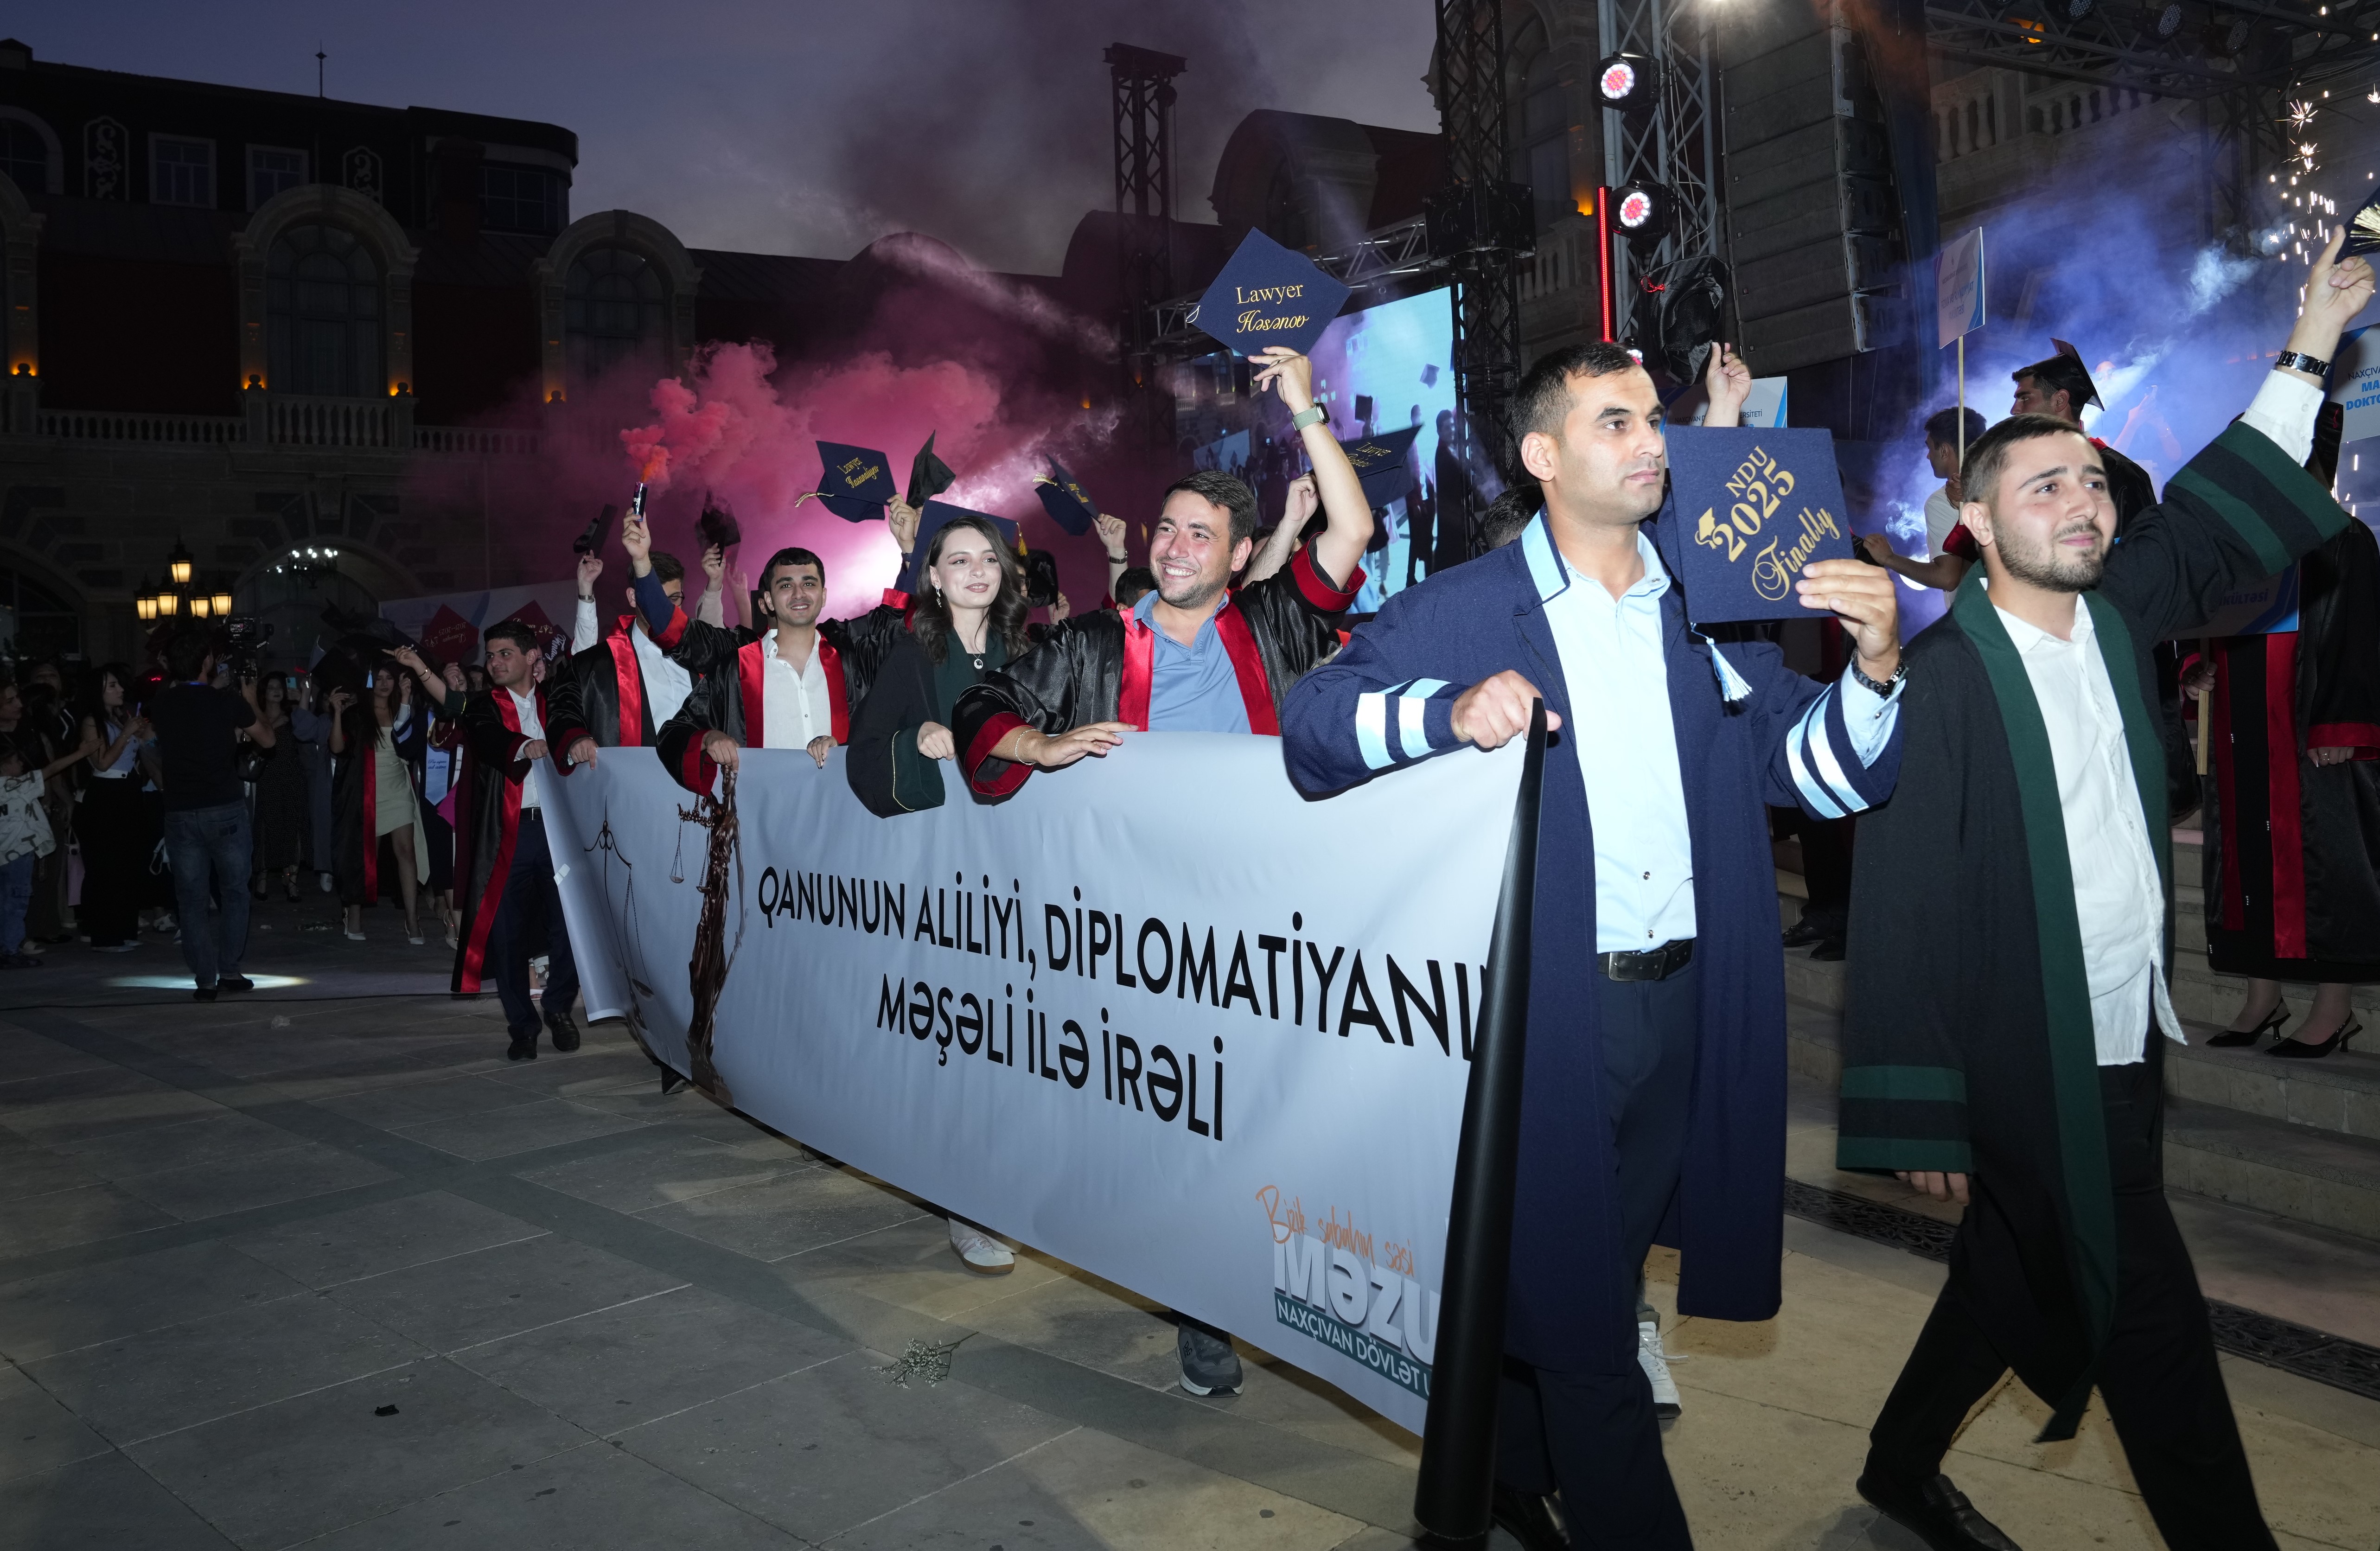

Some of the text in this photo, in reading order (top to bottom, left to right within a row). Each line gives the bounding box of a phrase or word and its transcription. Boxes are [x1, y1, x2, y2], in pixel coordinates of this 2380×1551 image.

[1235, 284, 1303, 305] Lawyer
[1237, 310, 1309, 333] Həsənov
[1740, 409, 1762, 418] ERSİTETİ
[1356, 442, 1391, 457] Lawyer
[837, 457, 862, 474] Lawyer
[1725, 446, 1767, 498] NDU
[1712, 458, 1794, 562] 2025
[1752, 507, 1840, 600] Finally
[2219, 588, 2269, 606] KÜLTƏSİ
[442, 632, 466, 643] Lawyer
[758, 866, 1487, 1062] QANUNUN ALİLİYİ, DİPLOMATİYANI
[876, 973, 1224, 1141] MƏŞƏLİ İLƏ İRƏLİ
[1385, 1239, 1414, 1277] səsi
[1277, 1299, 1353, 1354] NAXÇIVAN
[1356, 1337, 1420, 1391] DÖVLƏT
